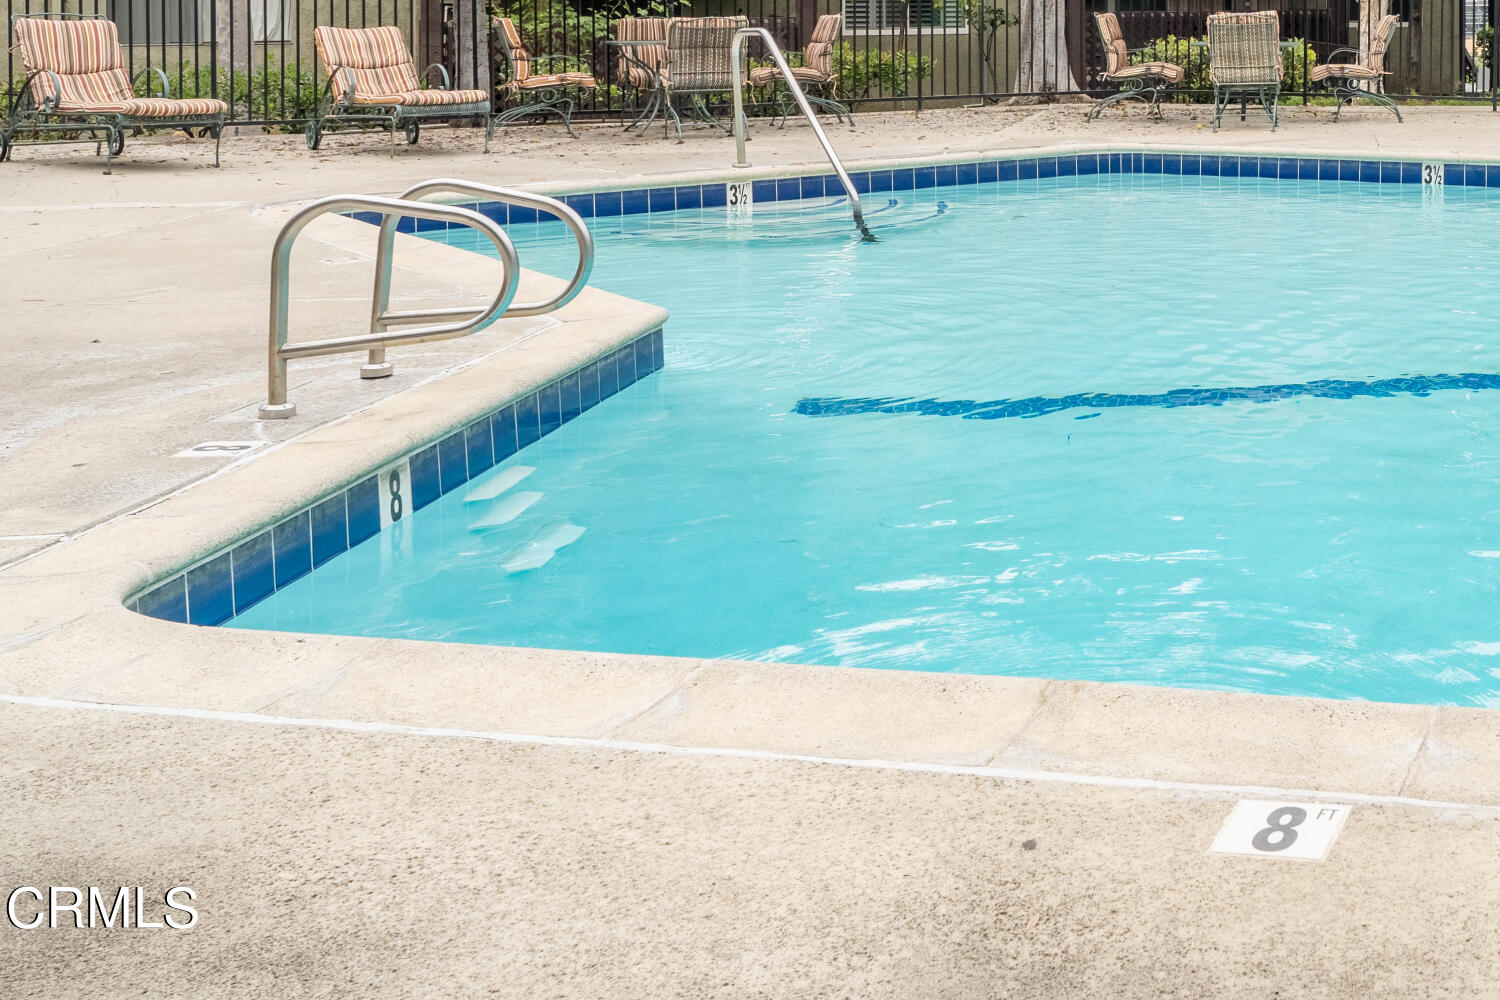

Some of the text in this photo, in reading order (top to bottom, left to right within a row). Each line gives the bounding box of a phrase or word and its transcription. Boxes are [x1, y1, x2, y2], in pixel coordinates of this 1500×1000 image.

[389, 470, 403, 522] 8
[1251, 806, 1340, 852] 8 FT
